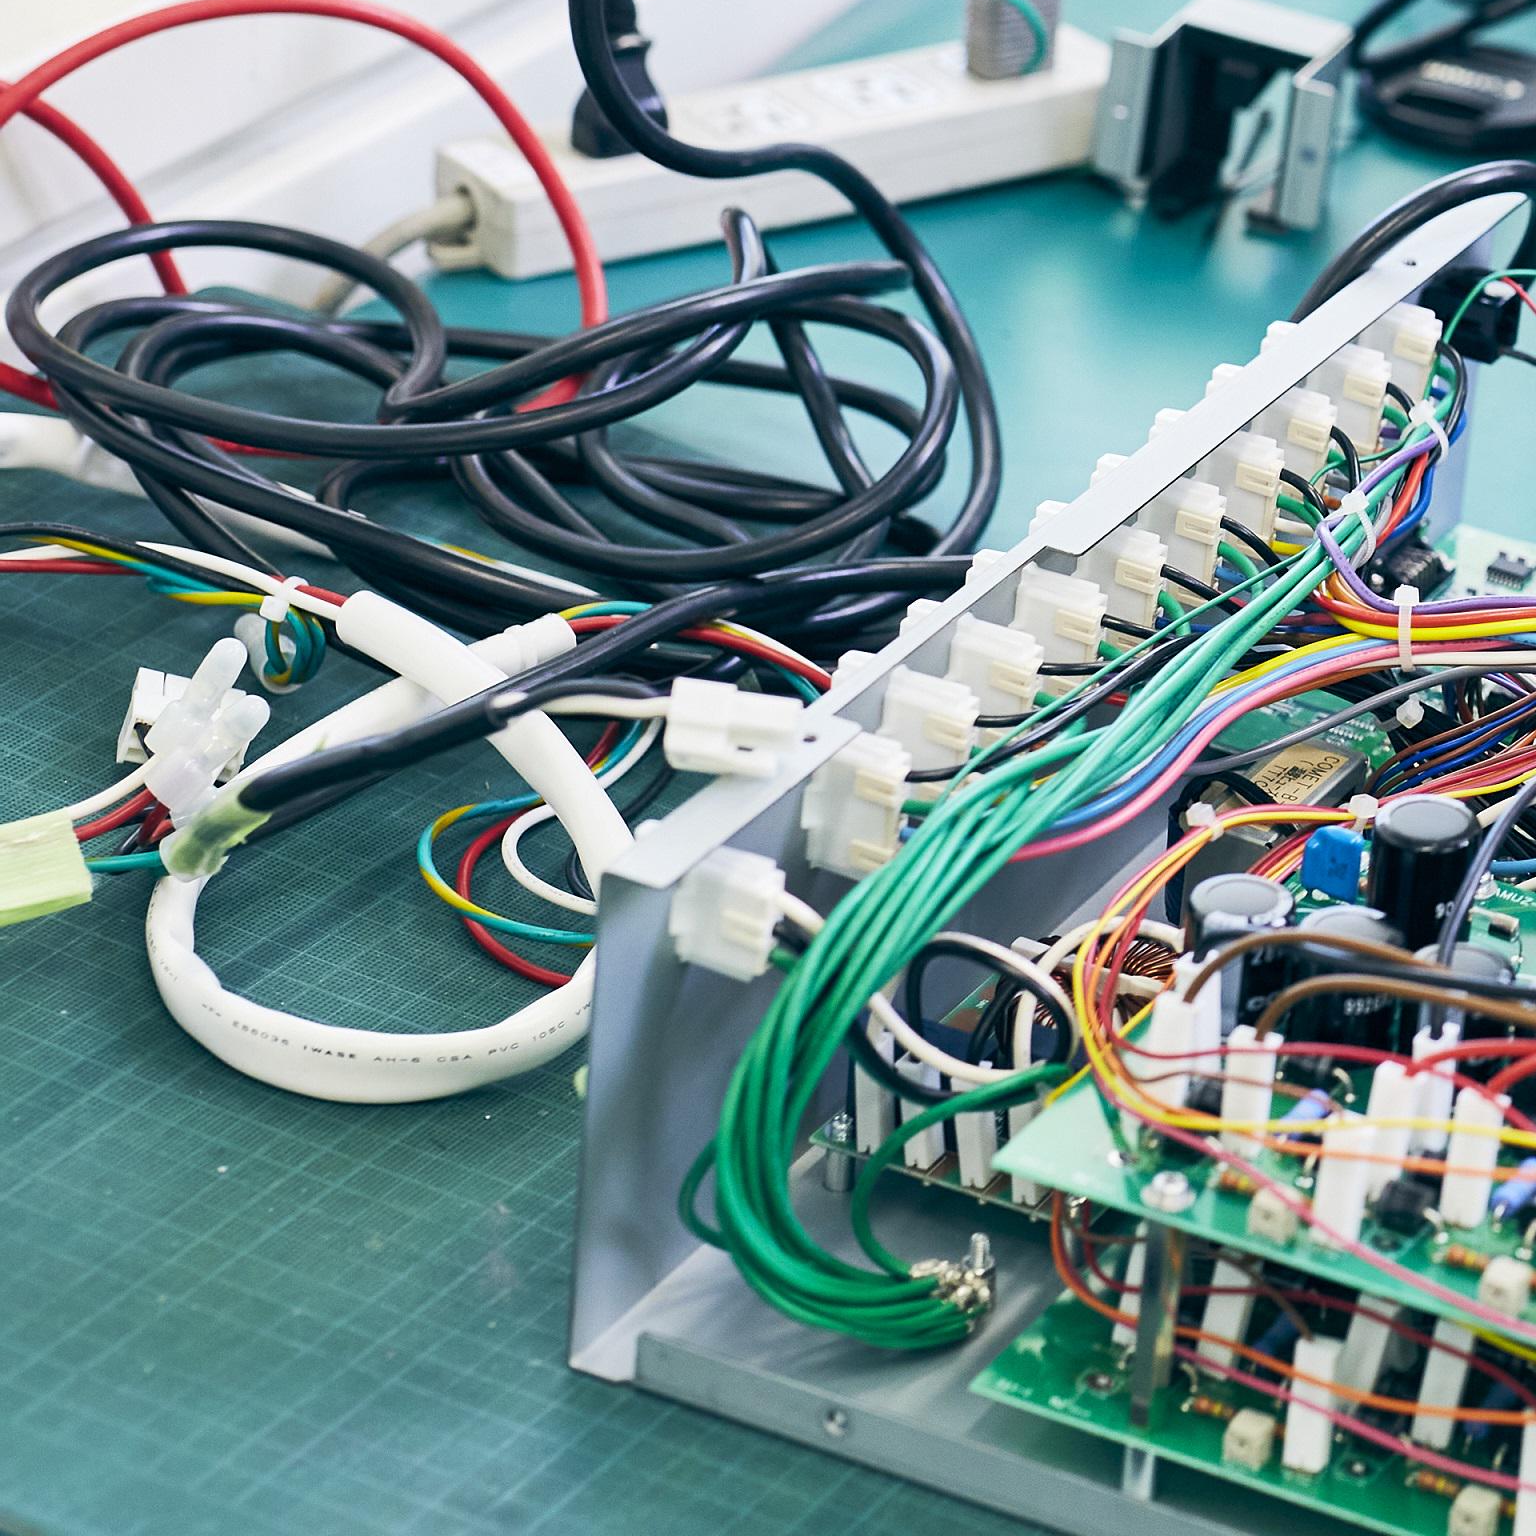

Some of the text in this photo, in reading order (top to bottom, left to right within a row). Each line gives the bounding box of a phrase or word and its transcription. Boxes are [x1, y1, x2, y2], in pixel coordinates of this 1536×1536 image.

[303, 1045, 357, 1059] IWASE
[437, 1054, 473, 1063] CSA
[488, 1041, 519, 1056] PVC
